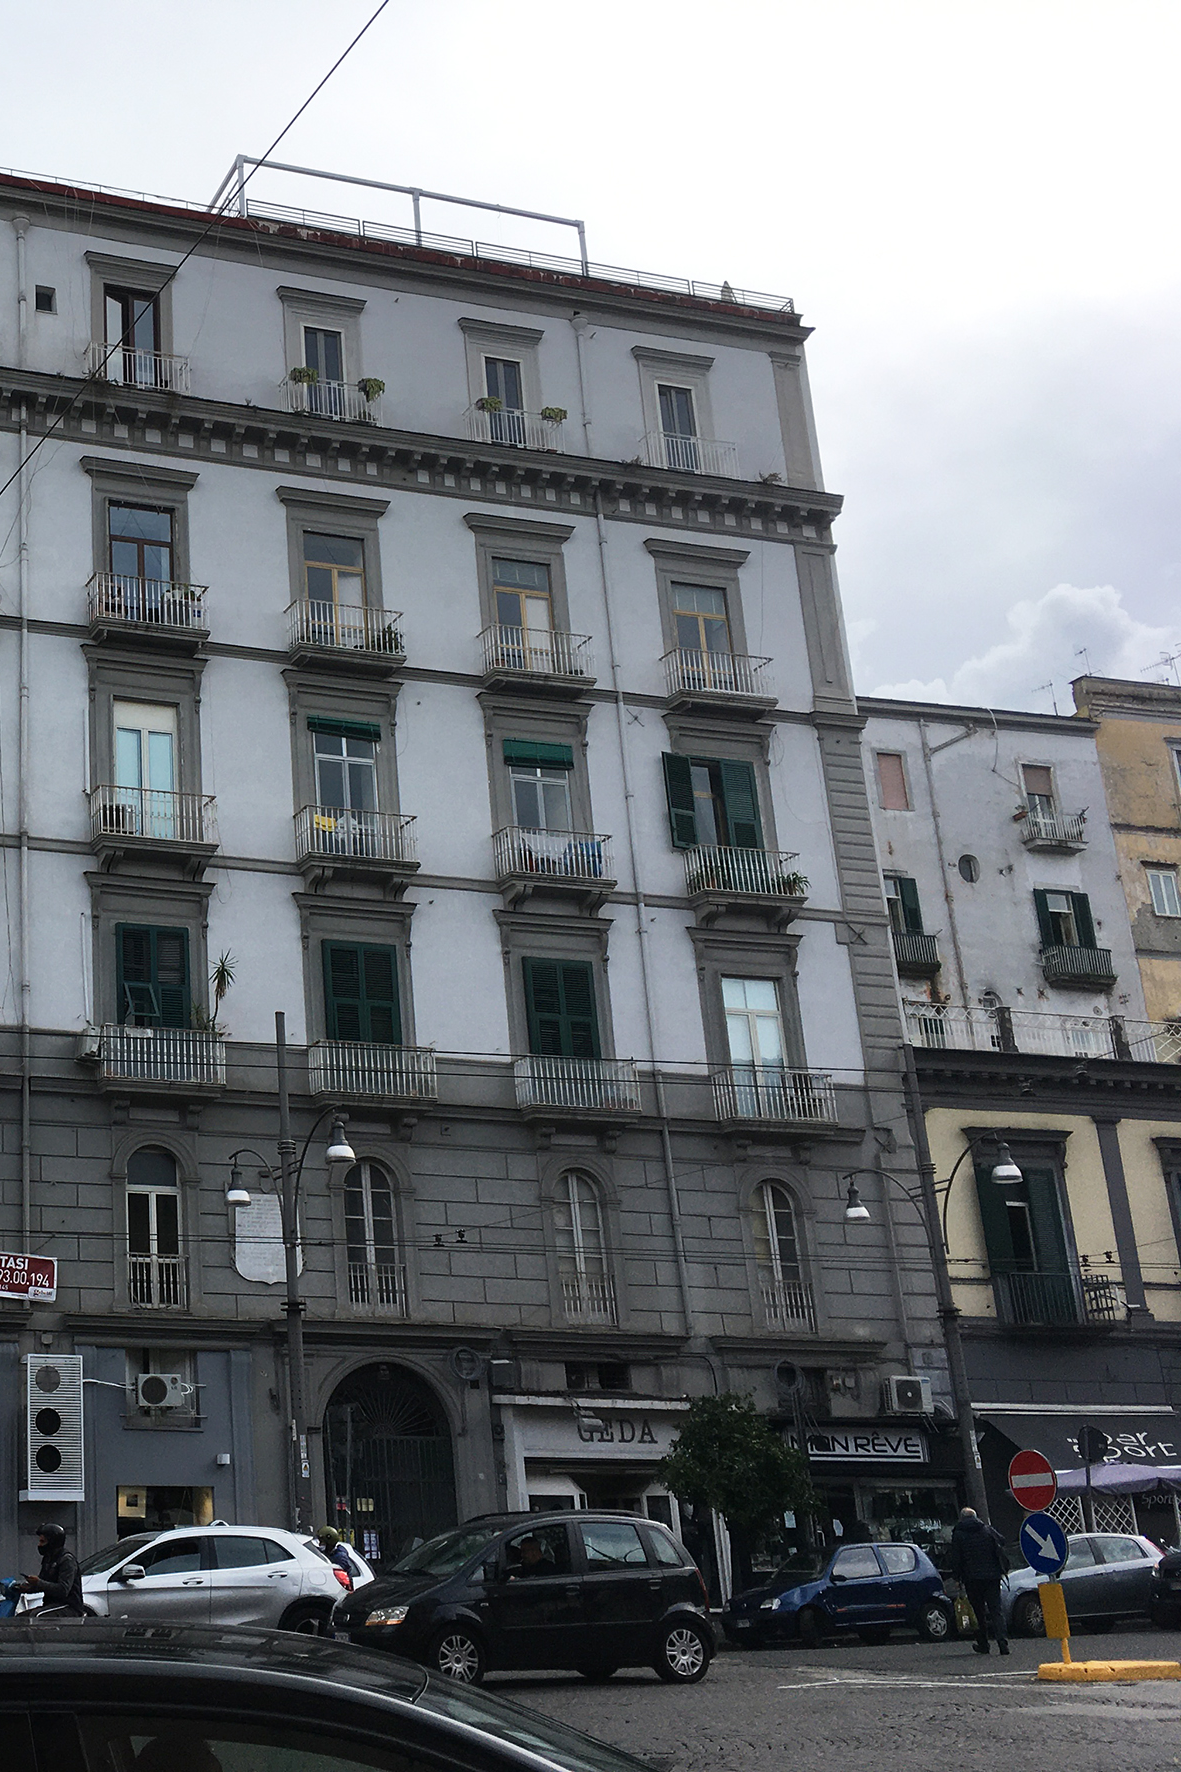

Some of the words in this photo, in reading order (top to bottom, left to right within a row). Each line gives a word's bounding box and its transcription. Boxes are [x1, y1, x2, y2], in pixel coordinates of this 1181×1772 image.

[577, 1419, 658, 1444] GEDA
[853, 1431, 921, 1453] RÊVE
[1141, 1493, 1174, 1510] Sport
